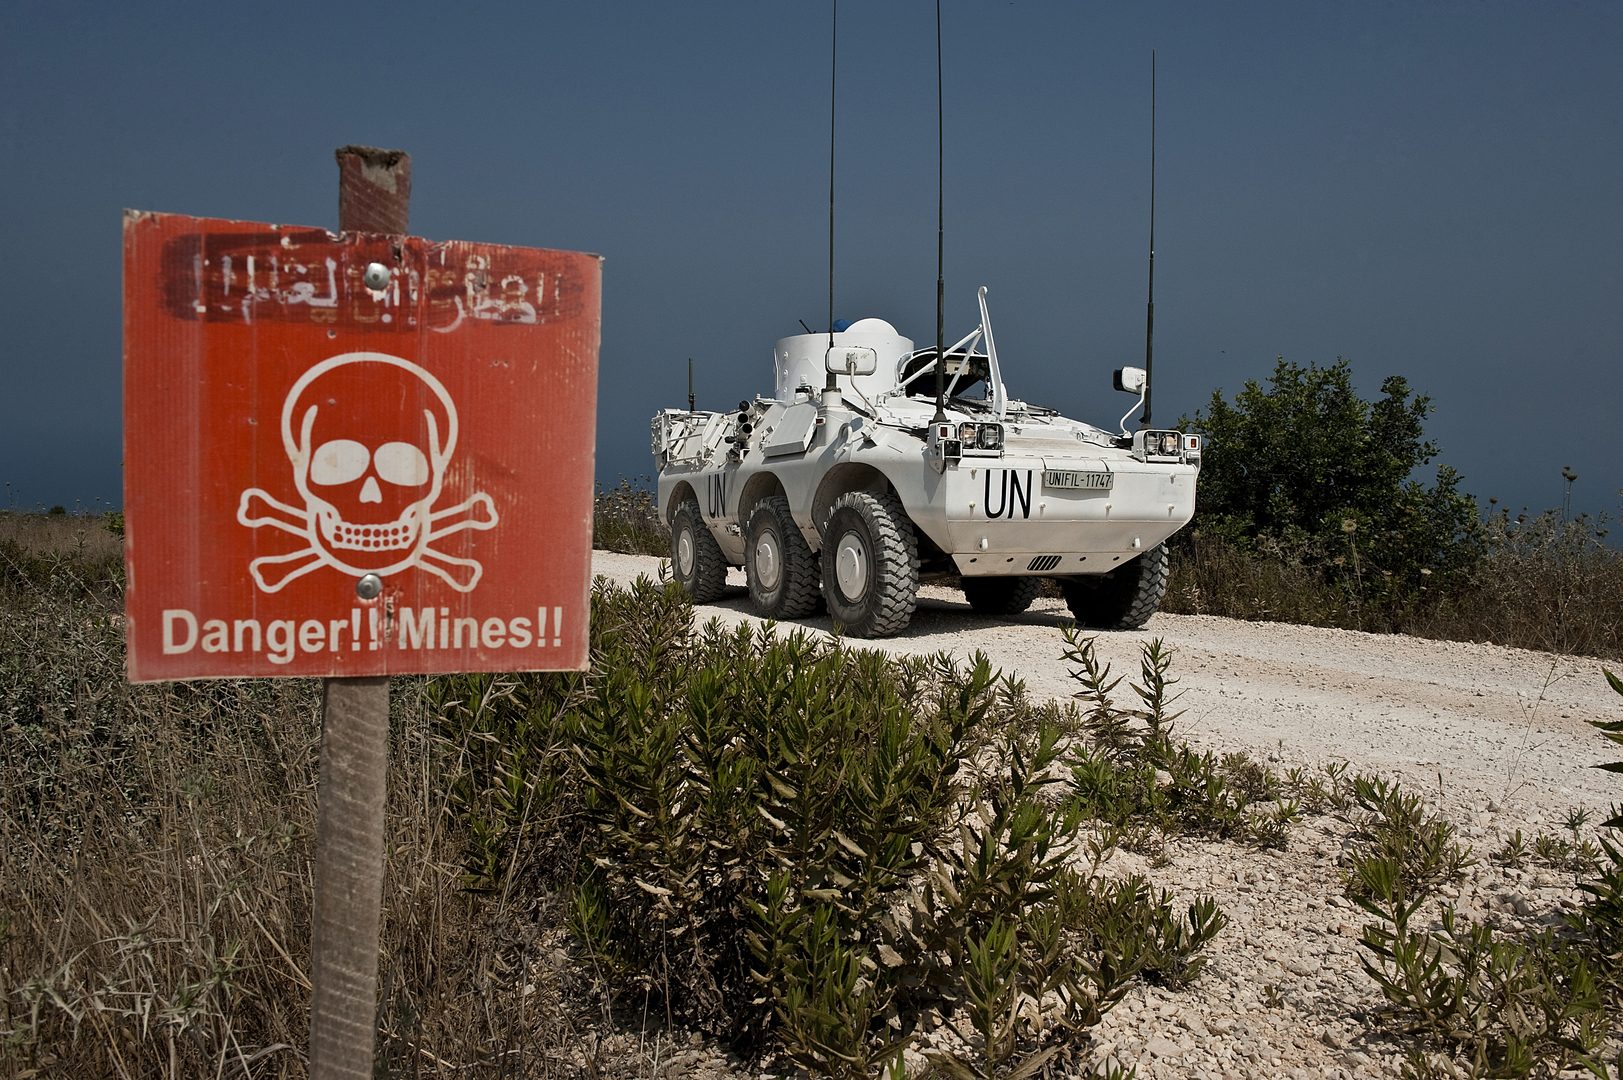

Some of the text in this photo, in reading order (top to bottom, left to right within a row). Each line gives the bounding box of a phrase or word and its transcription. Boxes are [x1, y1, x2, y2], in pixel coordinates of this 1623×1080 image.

[708, 472, 726, 519] UN
[984, 469, 1032, 518] UN
[1049, 472, 1111, 488] UNIFIL-11747
[162, 606, 562, 665] Danger!! Mines!!
